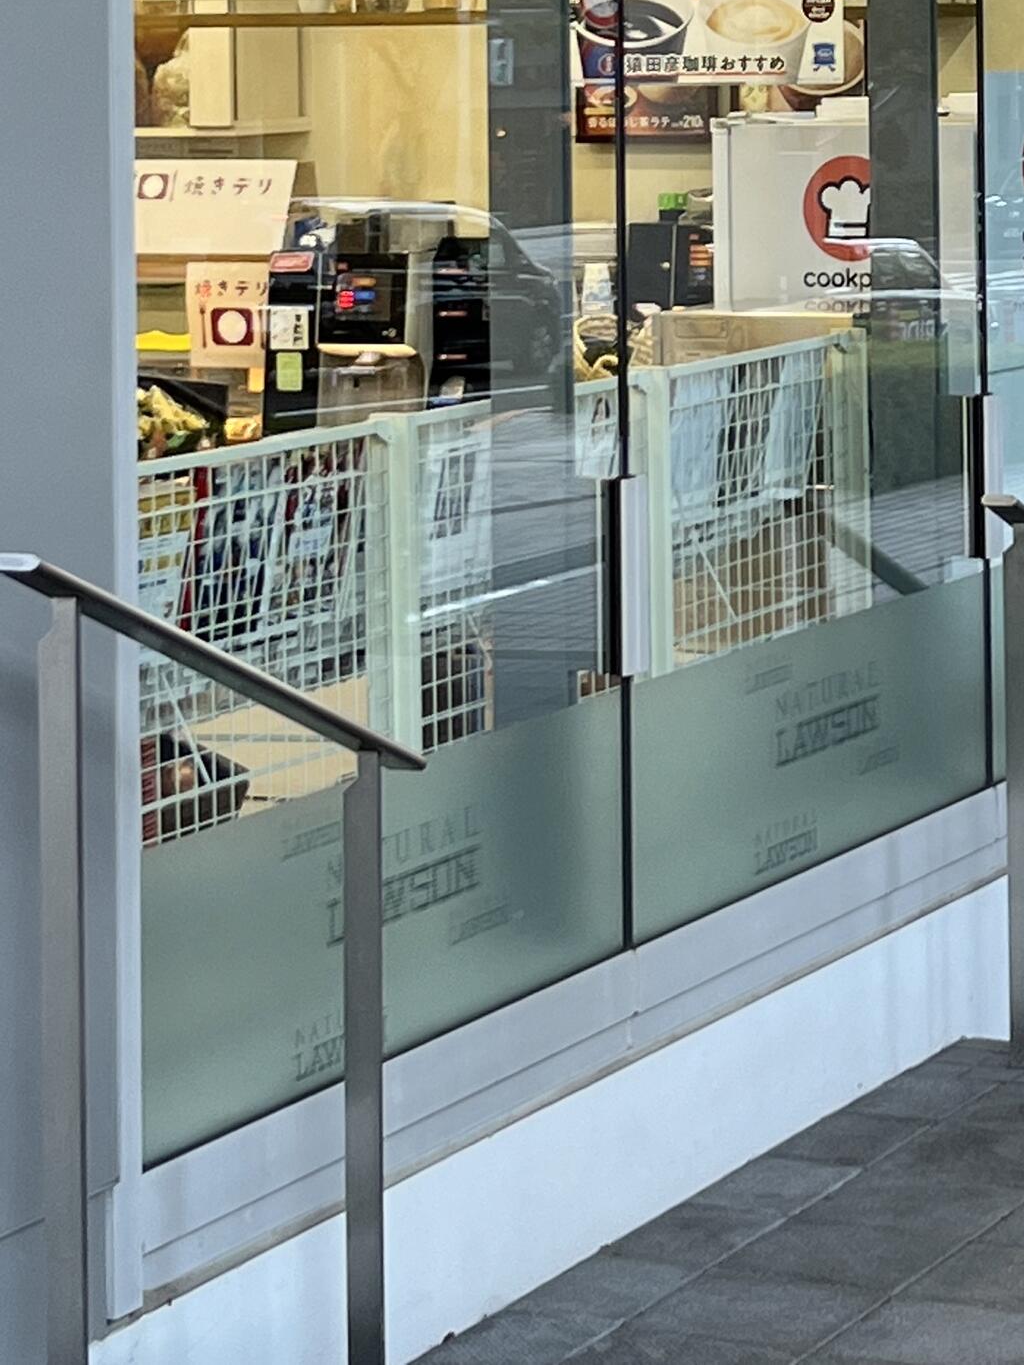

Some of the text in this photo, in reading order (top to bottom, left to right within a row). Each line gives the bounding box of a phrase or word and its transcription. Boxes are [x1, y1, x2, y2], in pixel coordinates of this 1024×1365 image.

[625, 54, 786, 73] 猿田彦珈琲おすすめ
